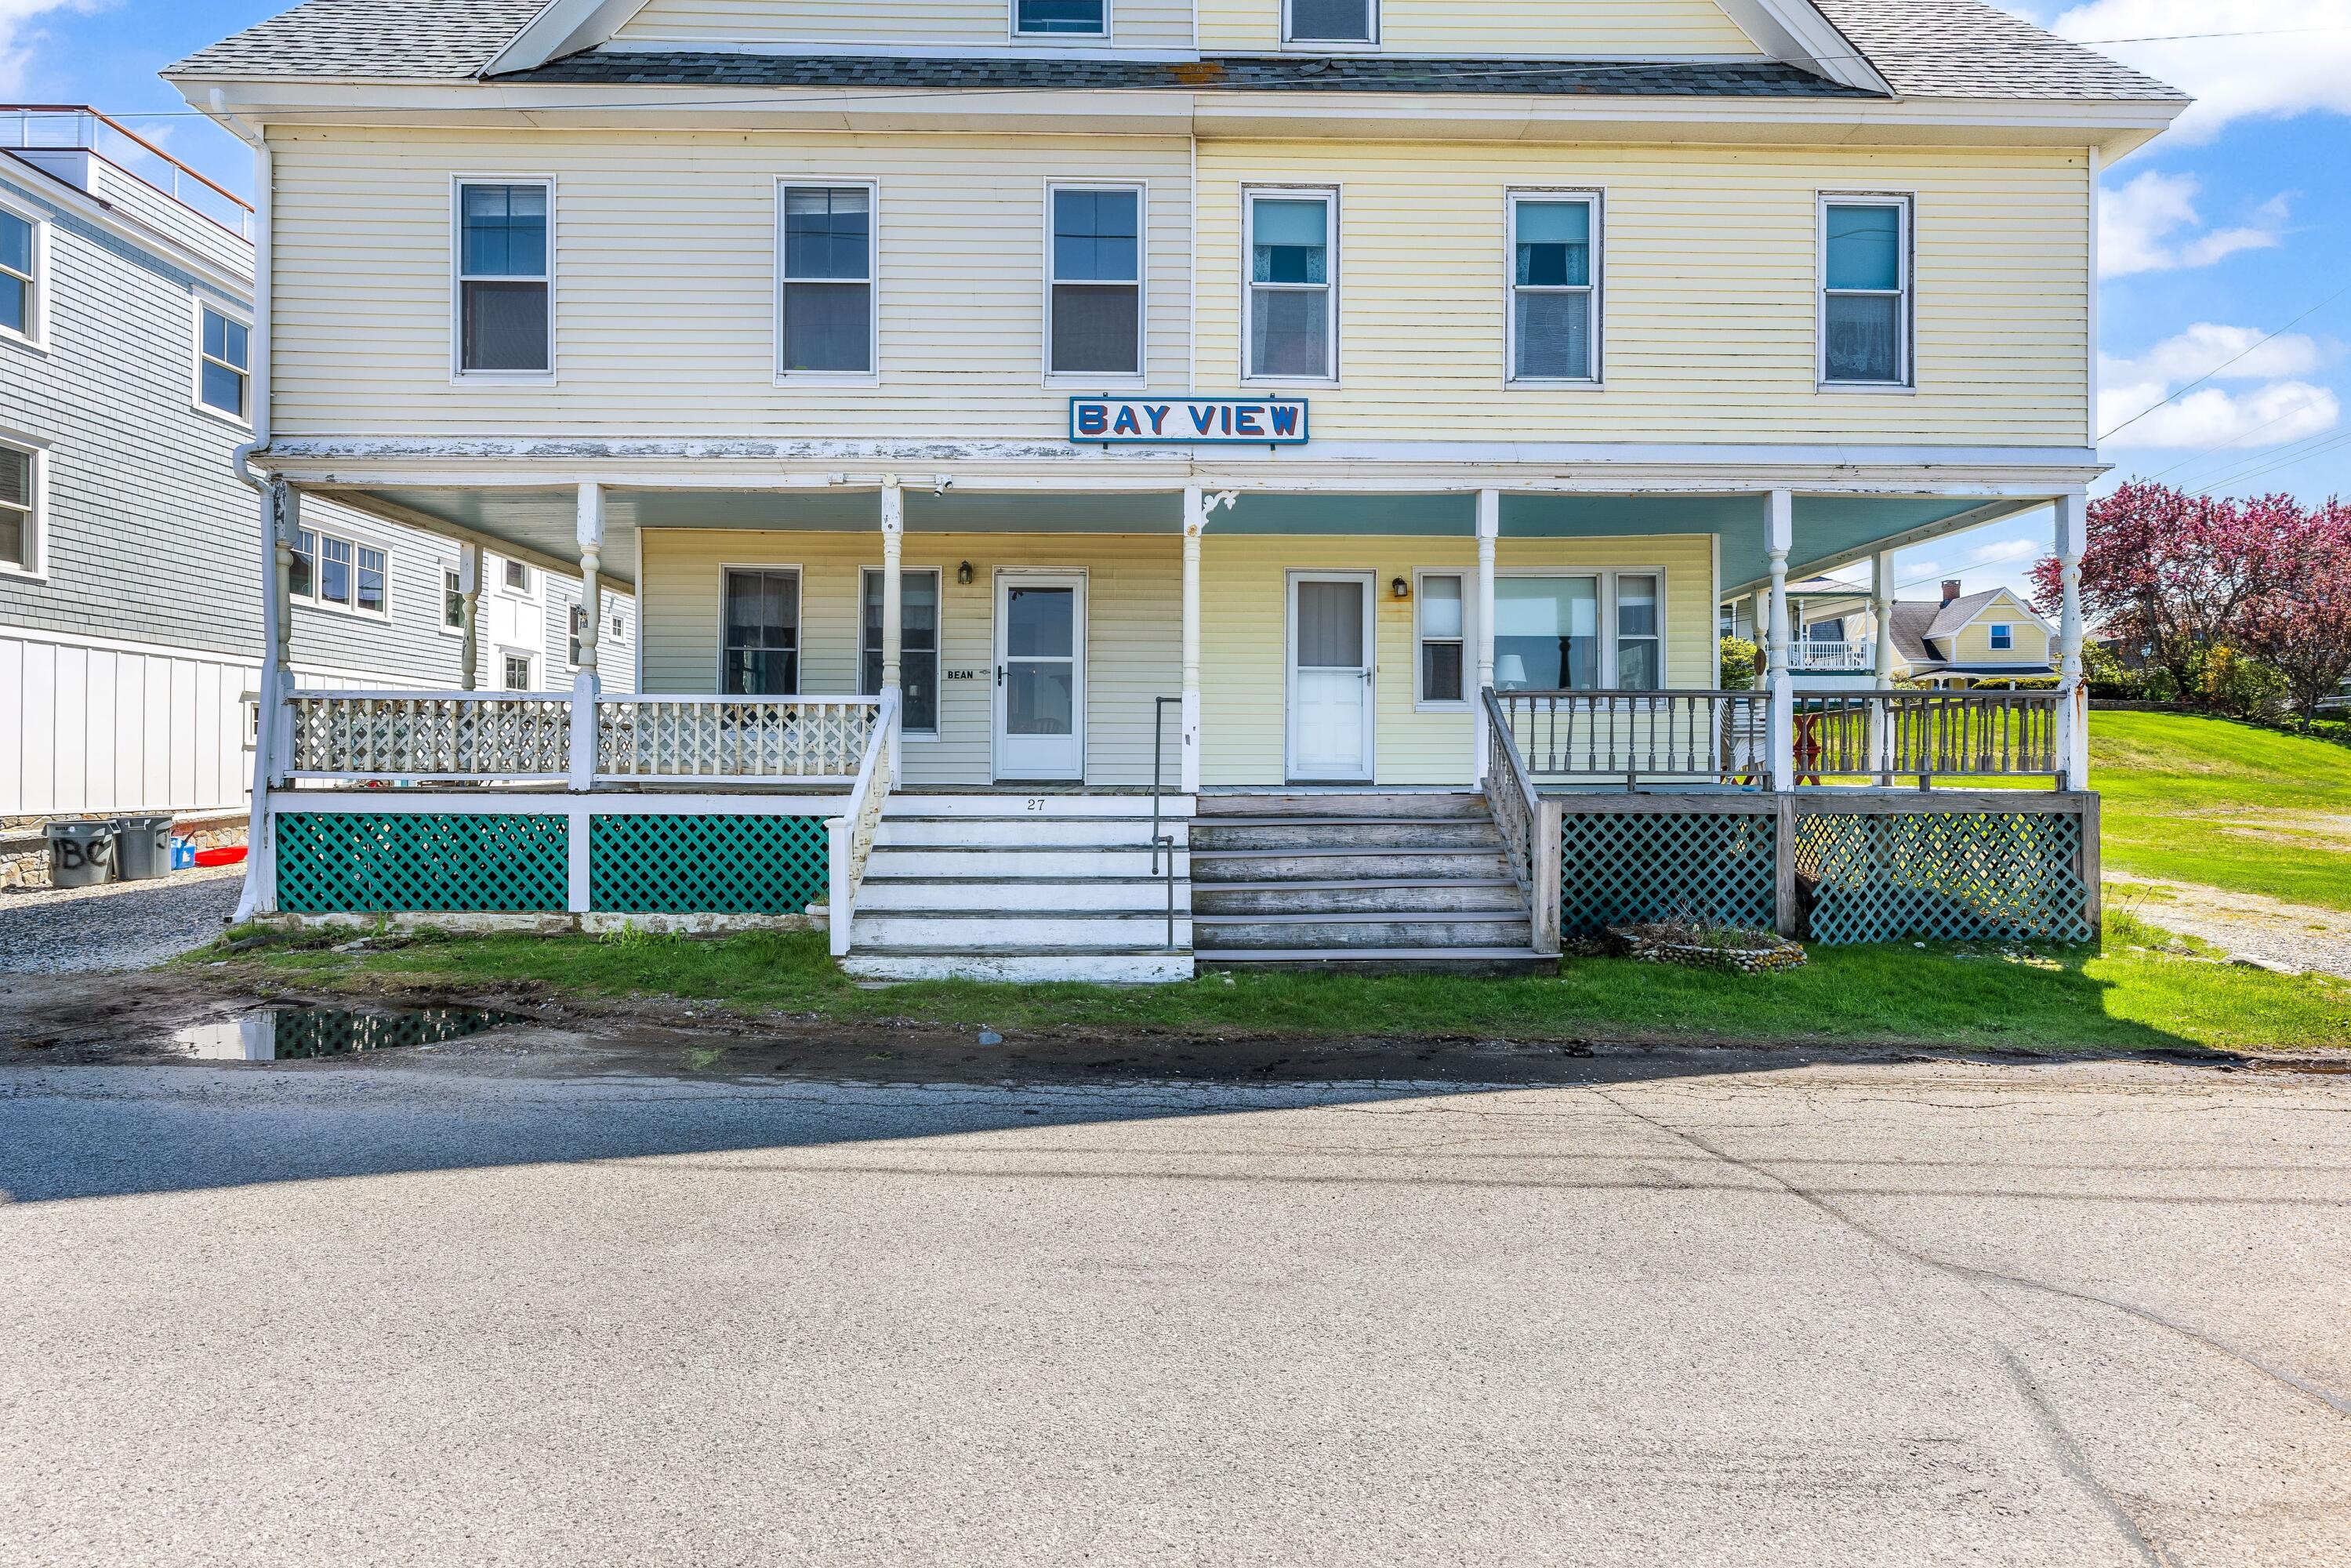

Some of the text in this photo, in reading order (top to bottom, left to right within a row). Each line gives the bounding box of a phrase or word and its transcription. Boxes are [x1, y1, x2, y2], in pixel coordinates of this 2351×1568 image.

[1078, 405, 1299, 435] BAY VIEW
[948, 670, 973, 679] BEAN
[1027, 799, 1045, 811] 27
